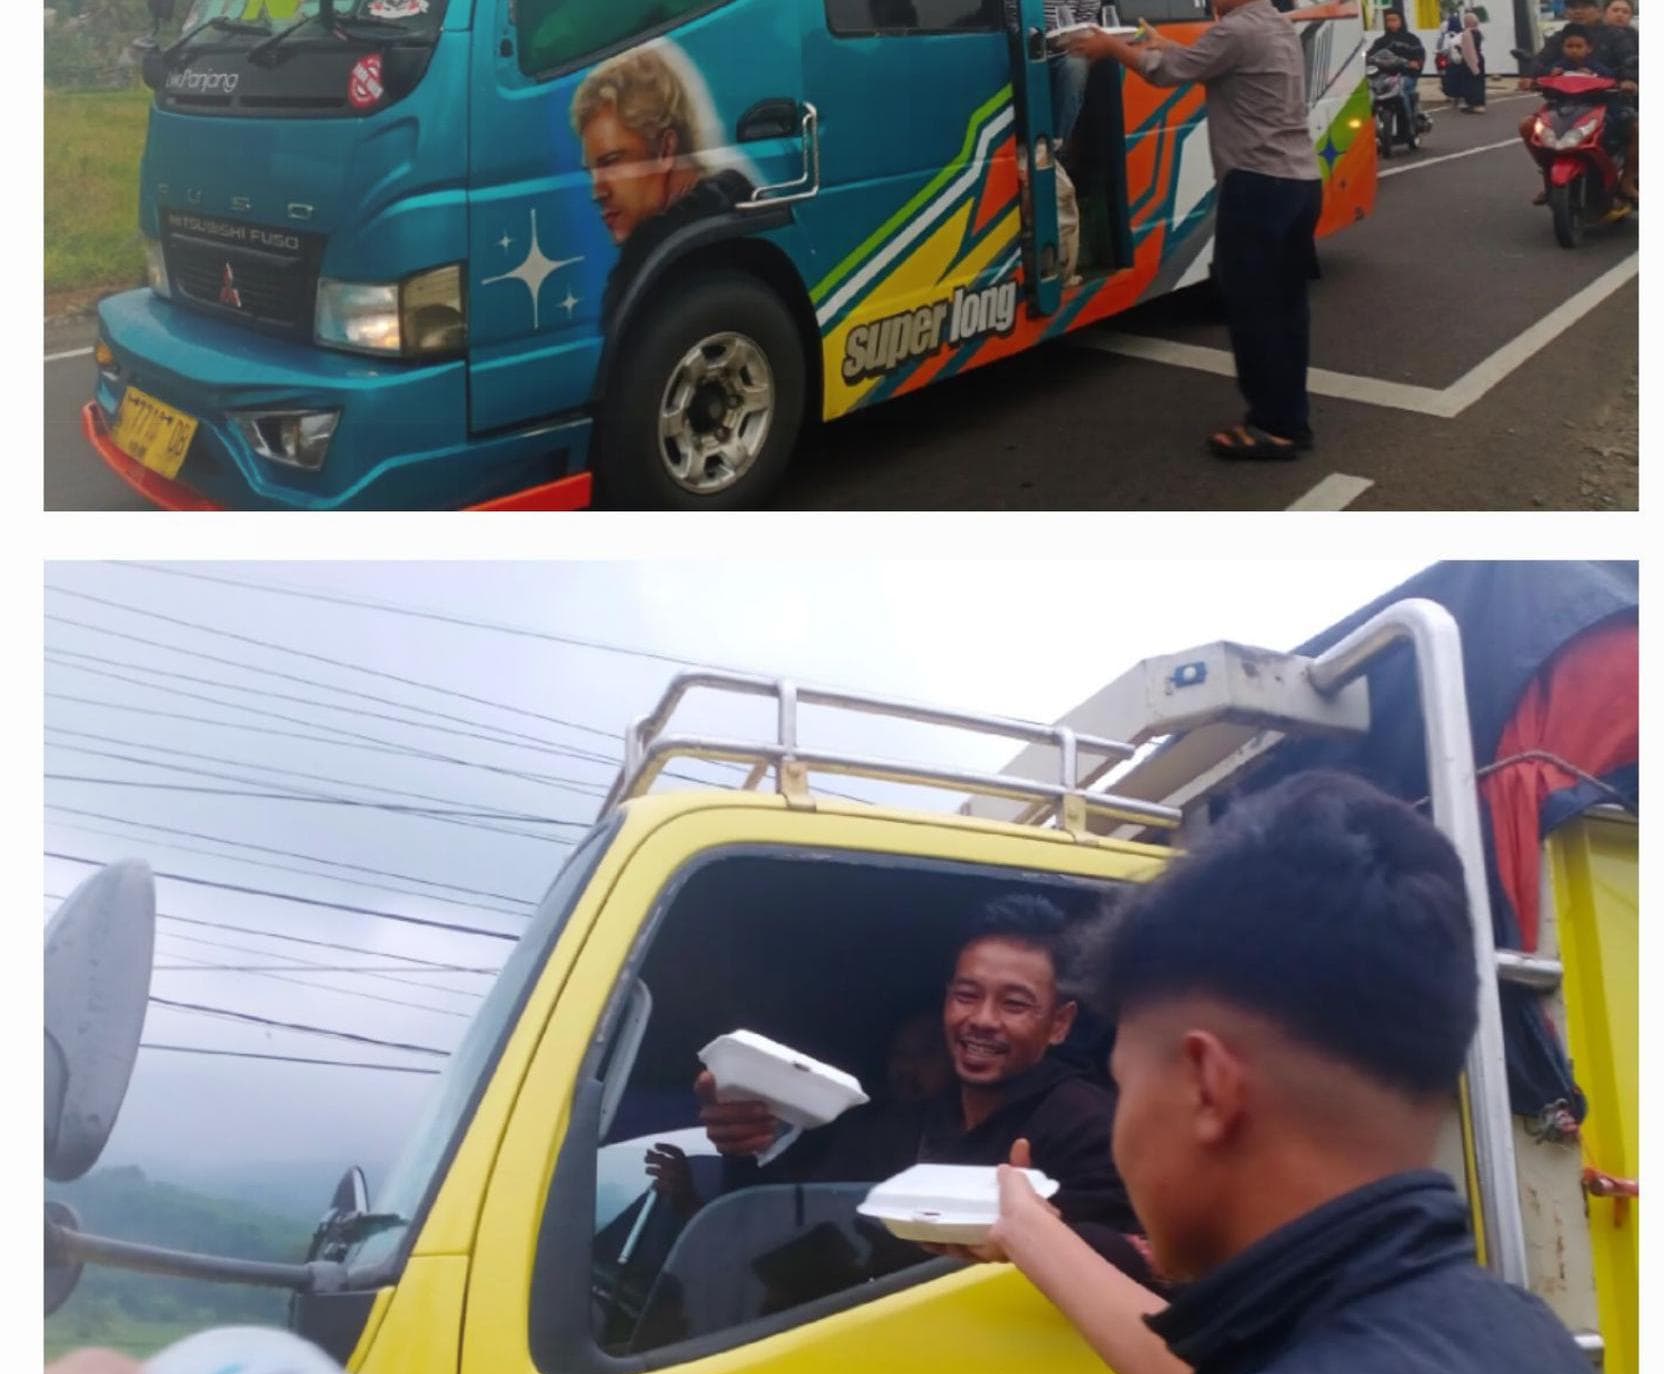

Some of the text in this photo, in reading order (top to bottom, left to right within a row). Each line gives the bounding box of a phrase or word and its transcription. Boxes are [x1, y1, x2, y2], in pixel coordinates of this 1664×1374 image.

[250, 229, 300, 250] FUSO
[842, 280, 1019, 381] super long
